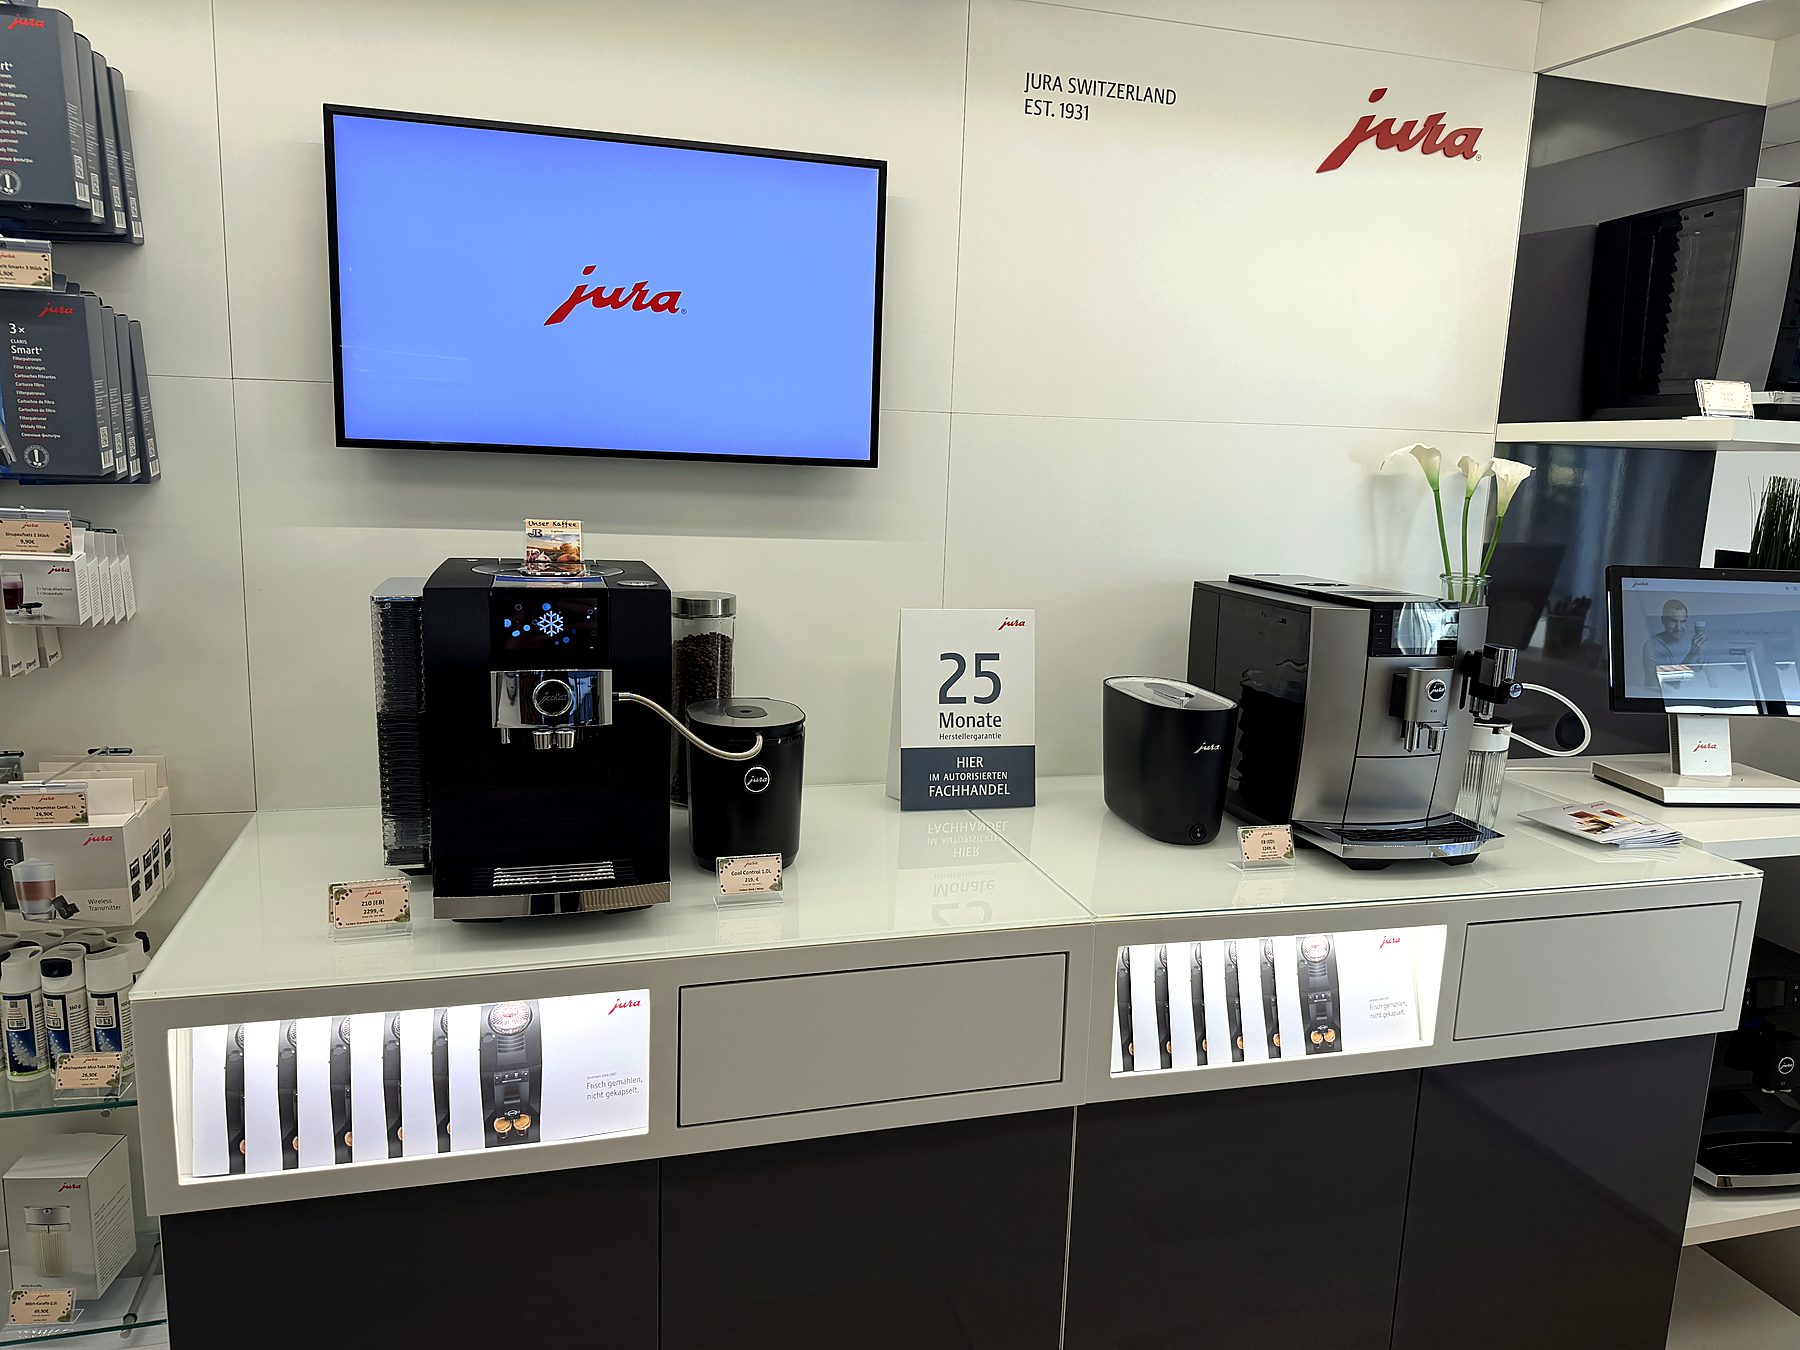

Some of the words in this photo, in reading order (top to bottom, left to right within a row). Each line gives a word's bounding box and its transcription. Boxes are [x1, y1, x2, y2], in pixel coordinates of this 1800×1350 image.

[8, 13, 45, 30] jura
[1024, 72, 1063, 93] JURA
[1067, 77, 1177, 105] SWITZERLAND
[1024, 98, 1055, 118] EST.
[1059, 102, 1089, 121] 1931
[1316, 87, 1484, 174] jura
[543, 265, 683, 326] jura
[38, 302, 74, 318] jura
[9, 322, 17, 334] 3
[528, 520, 549, 528] Unser
[552, 520, 577, 529] Kaffee
[47, 565, 71, 575] jura
[998, 617, 1026, 631] jura
[938, 652, 1002, 705] 25
[939, 712, 1002, 729] Monate
[939, 732, 1002, 741] Herstellergarantie
[1193, 741, 1221, 754] jura
[1693, 740, 1718, 752] jura
[956, 756, 984, 768] HIER
[929, 773, 940, 782] IM
[943, 771, 1008, 781] AUTORISIERTEN
[929, 783, 1010, 798] FACHHANDEL
[82, 833, 113, 847] jura
[1379, 936, 1401, 949] jura
[608, 998, 641, 1015] jura
[586, 1081, 606, 1090] Frisch
[607, 1076, 643, 1089] gemahlen,
[586, 1091, 604, 1100] nicht
[605, 1087, 640, 1099] gekapselt.
[58, 1182, 81, 1192] jura
